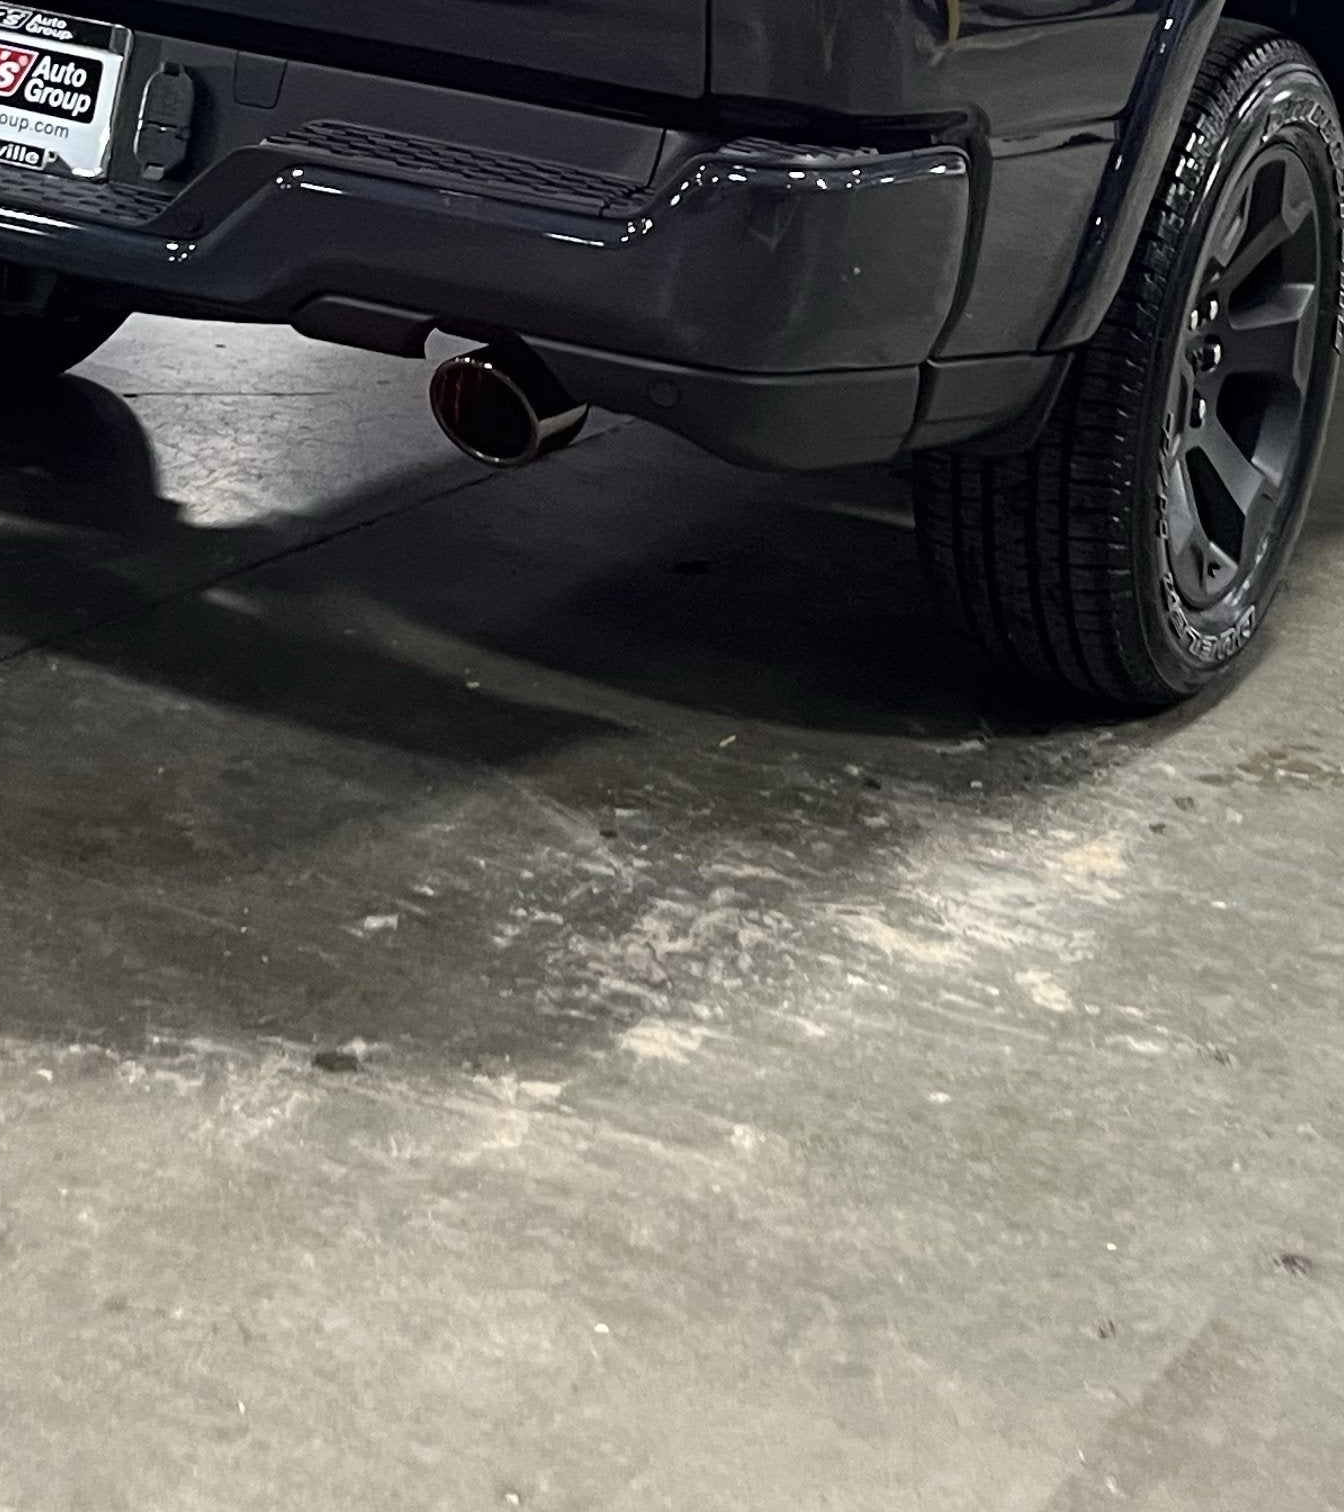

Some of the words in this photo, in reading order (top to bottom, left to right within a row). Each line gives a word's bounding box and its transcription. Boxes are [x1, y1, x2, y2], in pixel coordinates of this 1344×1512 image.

[25, 23, 73, 40] Group
[30, 13, 67, 29] Auto
[32, 55, 87, 88] Auto
[24, 79, 91, 117] Group
